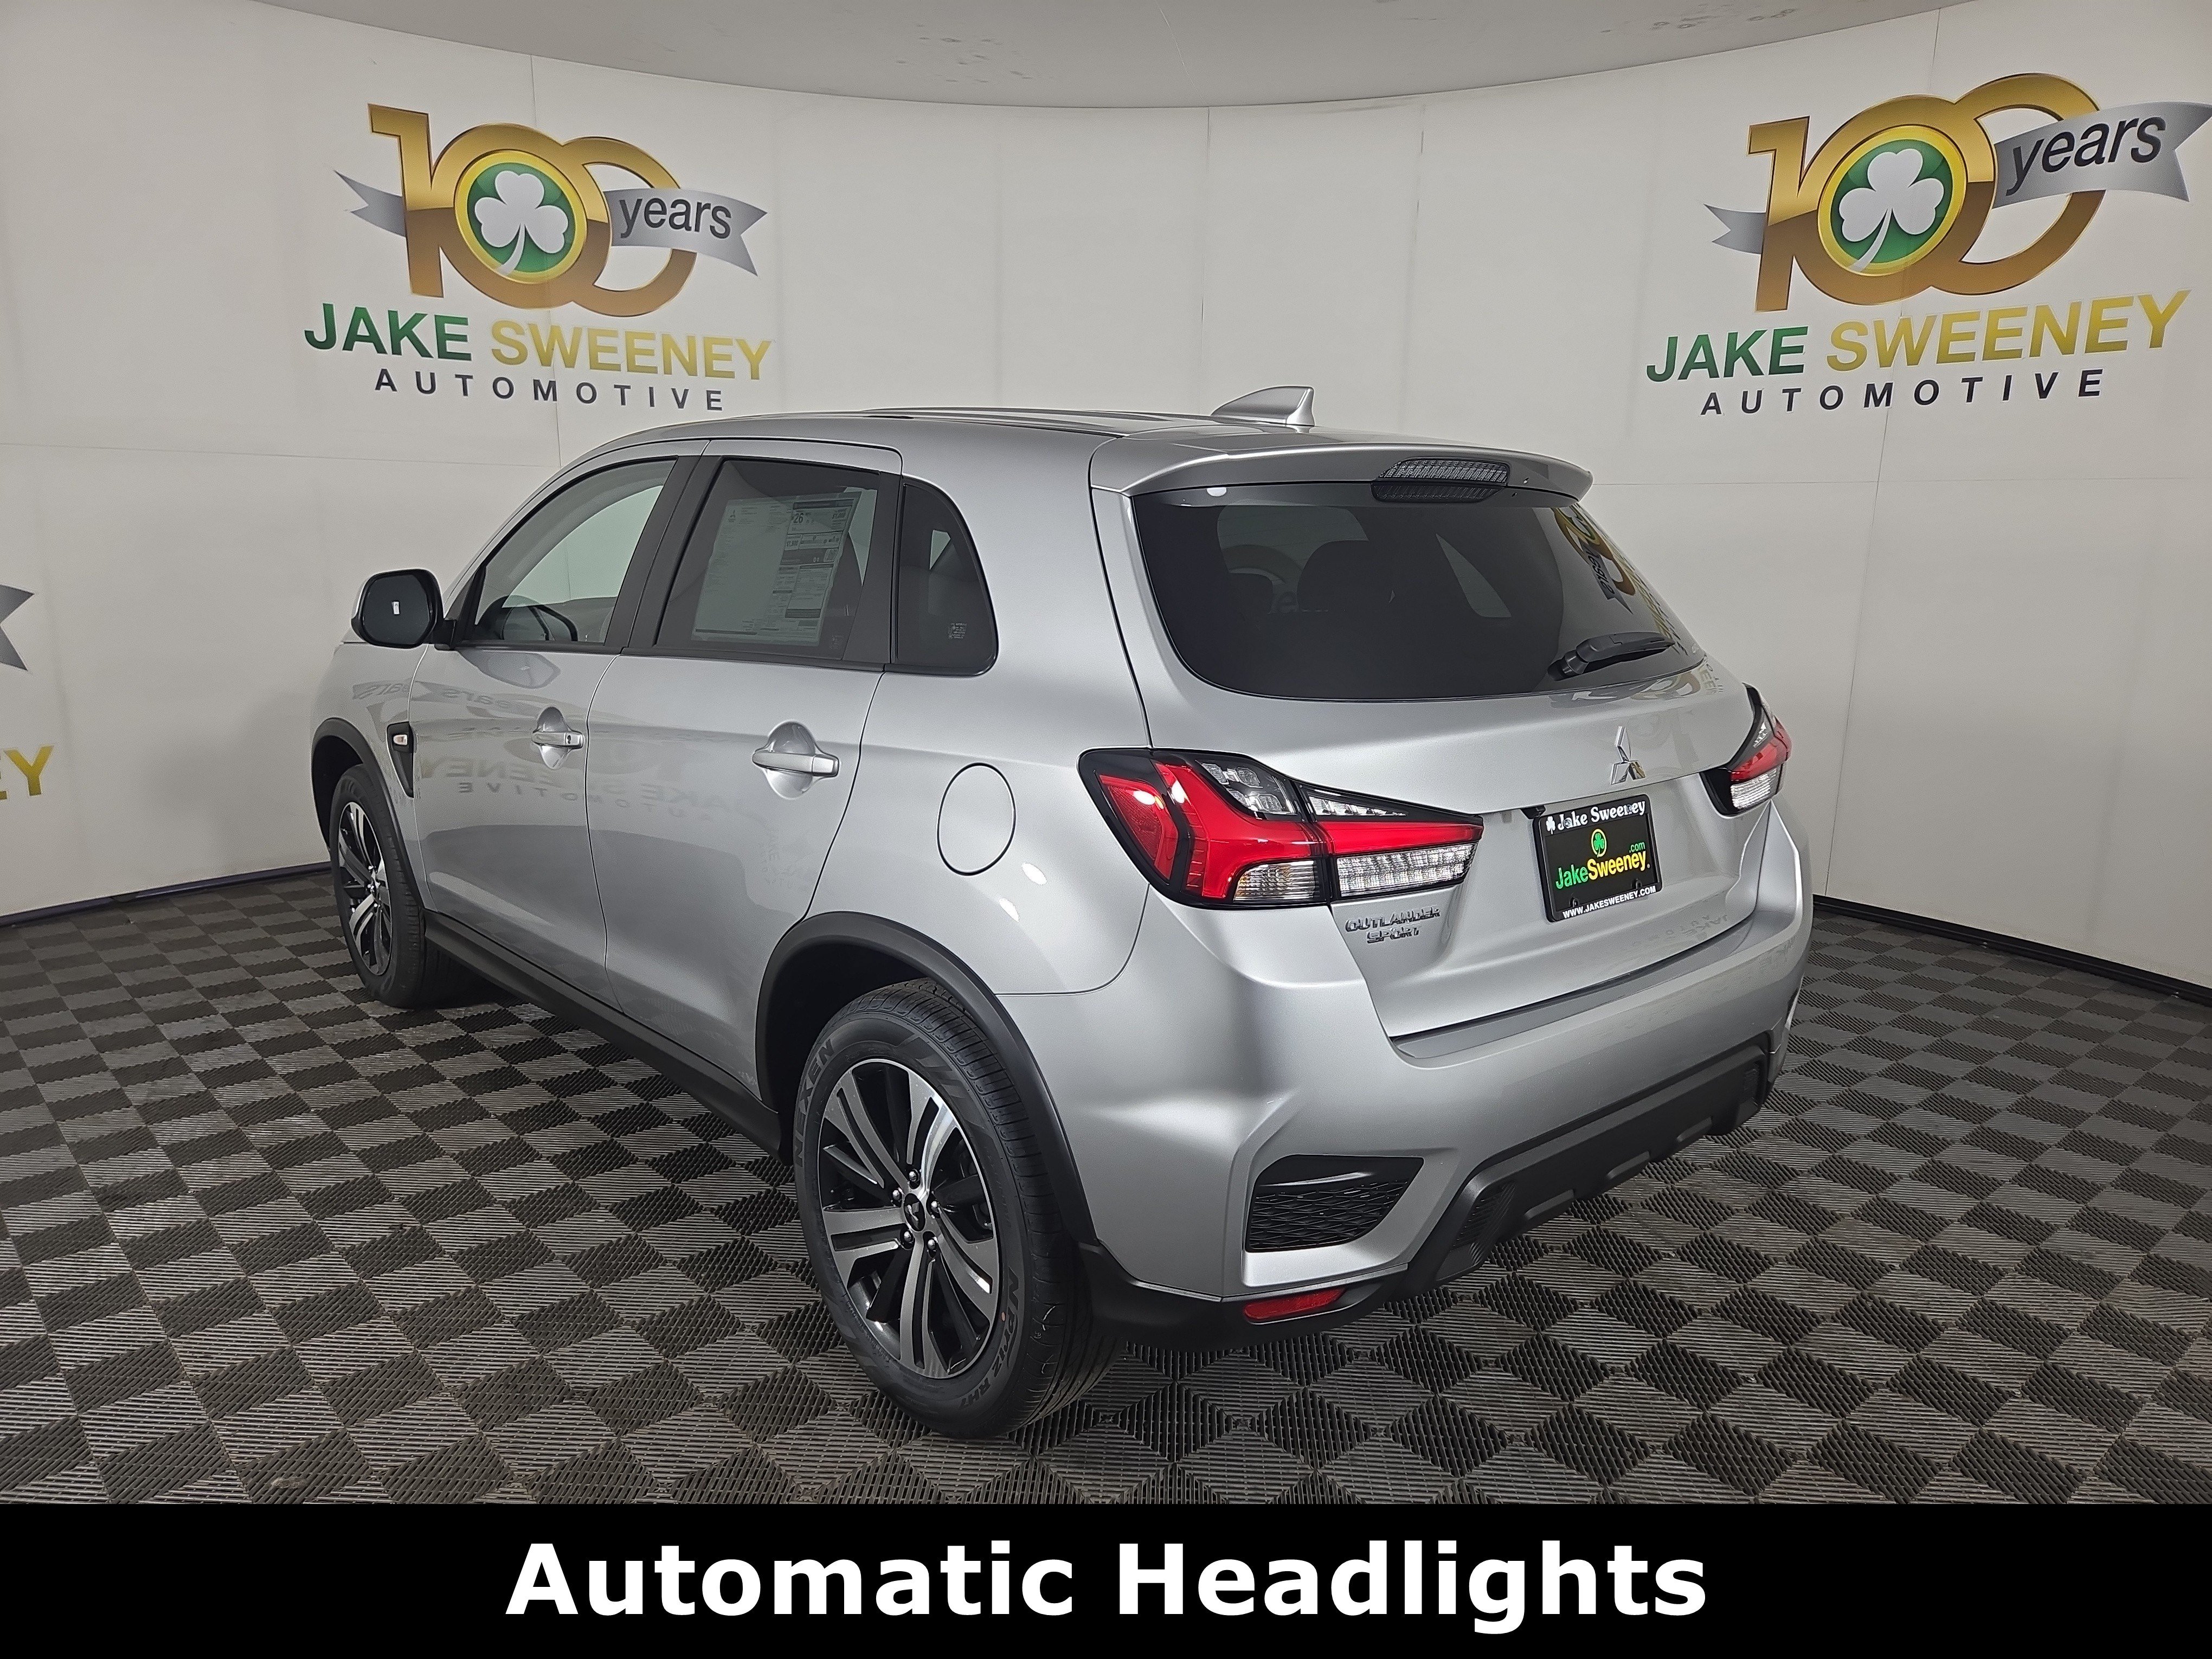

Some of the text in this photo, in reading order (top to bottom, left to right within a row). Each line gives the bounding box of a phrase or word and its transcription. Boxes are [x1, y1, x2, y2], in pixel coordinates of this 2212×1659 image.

[2006, 115, 2166, 196] years
[619, 197, 732, 239] years
[304, 303, 772, 380] JAKE SWEENEY
[1646, 290, 2191, 382] JAKE SWEENEY
[375, 369, 723, 411] AUTOMOTIVE
[1701, 369, 2103, 415] AUTOMOTIVE
[0, 745, 54, 800] Y
[1558, 801, 1645, 831] Jake Sweeney
[1629, 841, 1645, 853] .com
[1345, 906, 1441, 932] OUTLANDER
[1562, 885, 1656, 919] WWW.JAKESWEENEY.COM
[1367, 925, 1420, 943] SPORT
[795, 1038, 835, 1168] NEXEN
